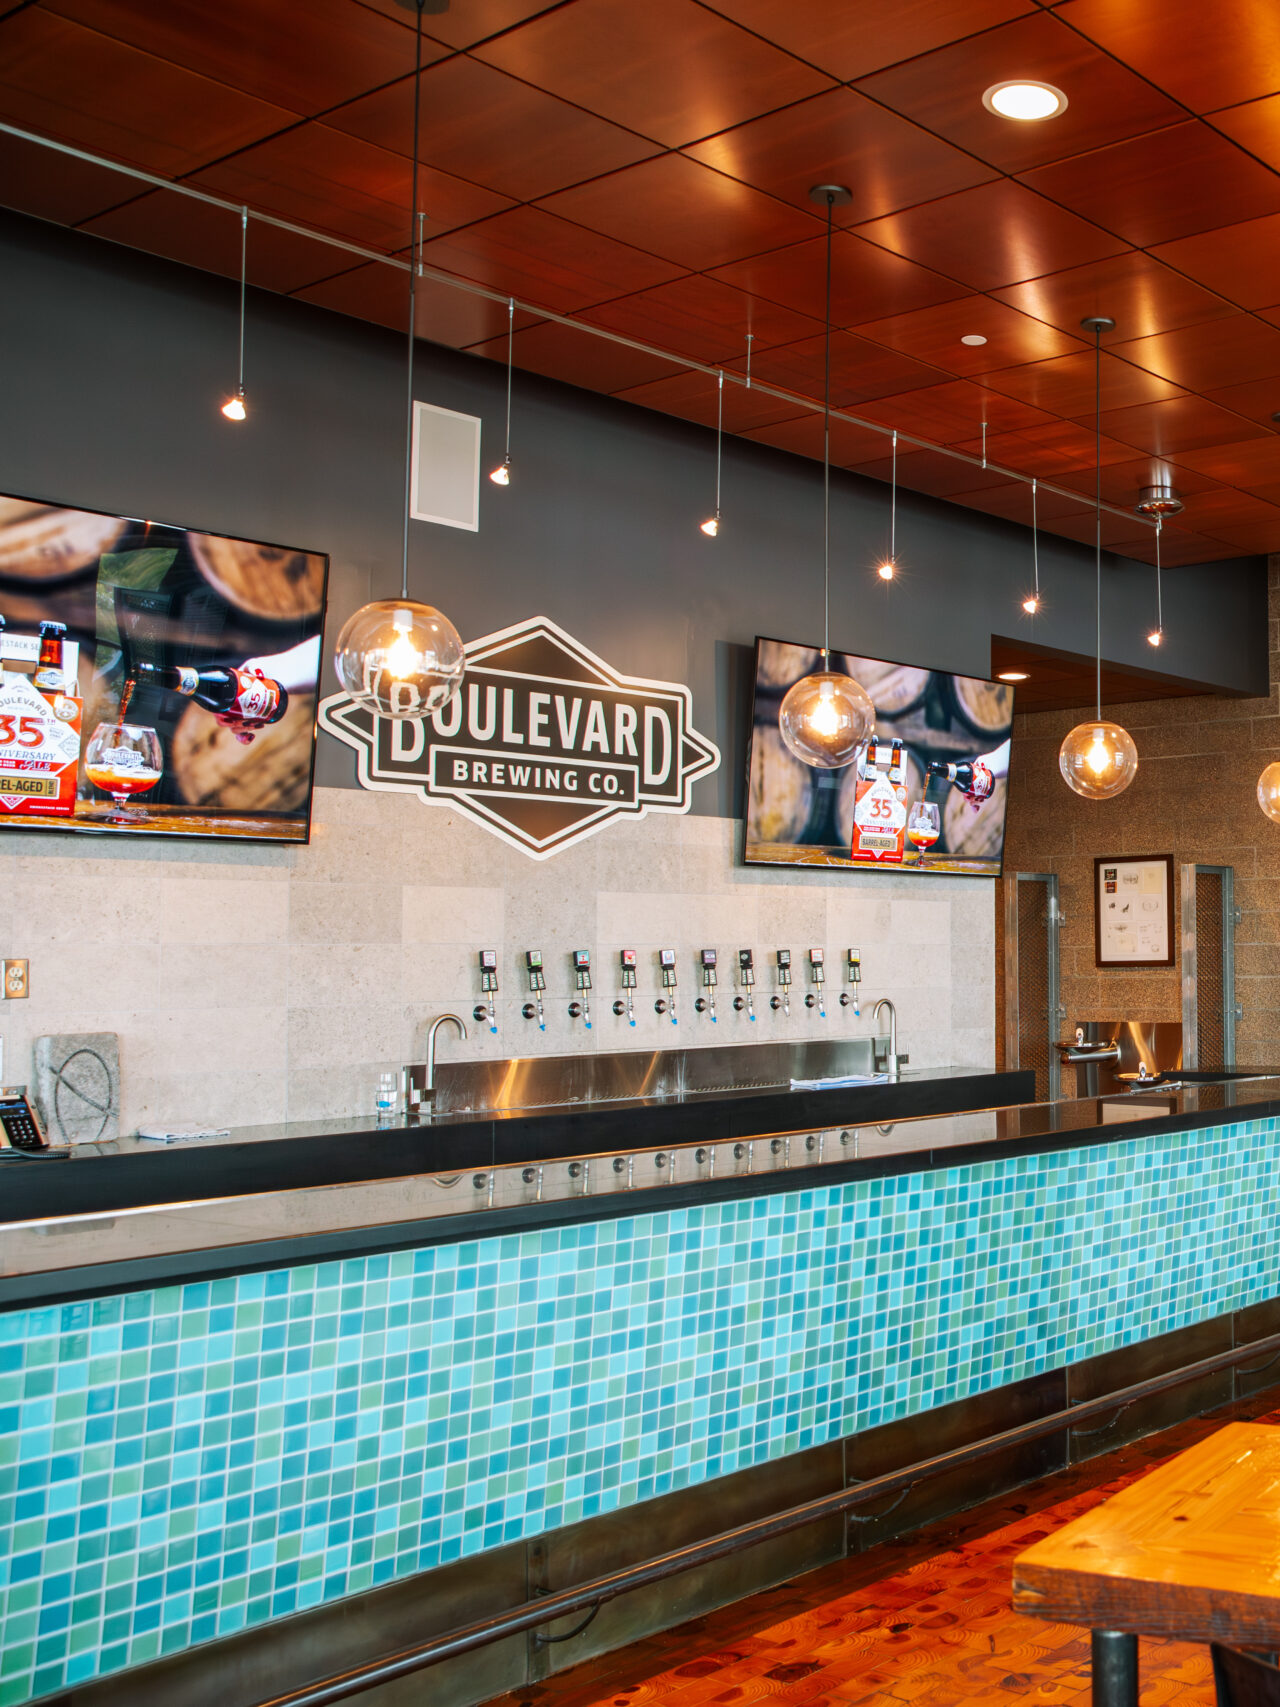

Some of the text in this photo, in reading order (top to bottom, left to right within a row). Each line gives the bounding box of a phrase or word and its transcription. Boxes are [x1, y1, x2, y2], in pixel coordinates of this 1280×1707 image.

[247, 693, 261, 711] 35
[0, 714, 45, 748] 35
[391, 680, 673, 786] BOULEVARD
[453, 759, 625, 796] BREWING CO.
[870, 797, 892, 819] 35
